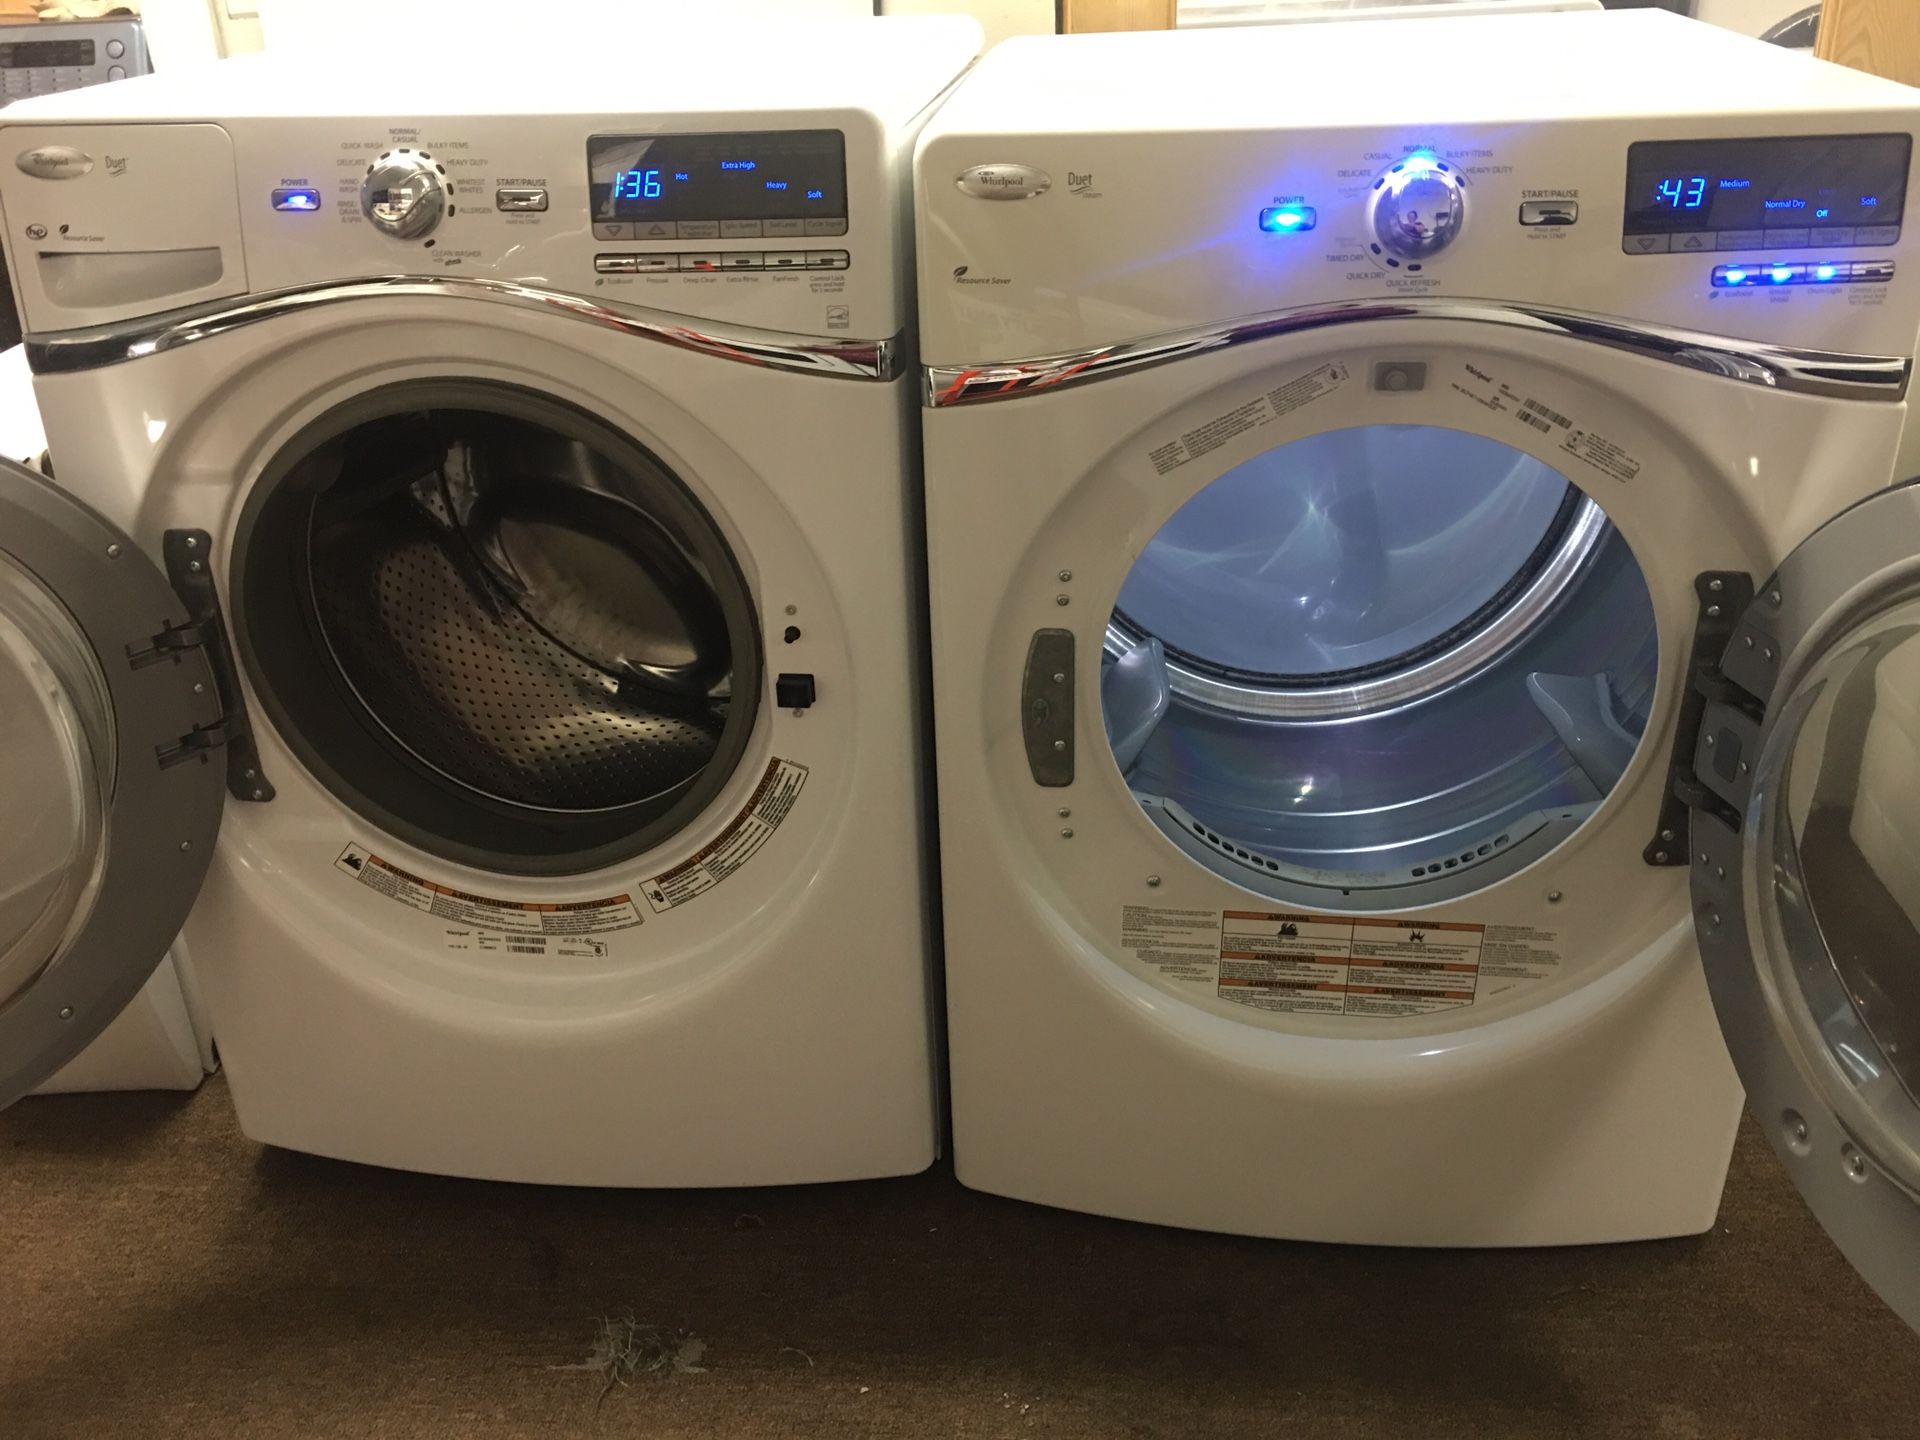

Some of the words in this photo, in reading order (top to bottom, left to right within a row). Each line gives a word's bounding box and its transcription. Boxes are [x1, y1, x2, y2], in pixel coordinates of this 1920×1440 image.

[1403, 145, 1436, 153] NORMAL
[105, 155, 127, 169] Duet
[721, 161, 739, 170] Extra
[739, 161, 756, 170] High
[1338, 170, 1372, 178] DELICATE
[1492, 166, 1513, 174] DUTY
[675, 172, 688, 180] Hot
[1067, 172, 1093, 186] Duet
[496, 178, 547, 187] START/PAUSE
[614, 170, 661, 198] 1:36
[766, 181, 787, 191] Heavy
[981, 176, 1023, 188] Whirlpool
[1720, 179, 1750, 188] Medium
[807, 190, 822, 198] Soft
[1522, 189, 1579, 198] START/PAUSE
[1273, 196, 1305, 204] POWER
[1765, 200, 1791, 209] Normal
[1792, 199, 1806, 210] Dry
[1860, 196, 1877, 206] Soft
[1816, 209, 1829, 218] Off
[1326, 254, 1349, 262] TIMED
[683, 276, 699, 284] Deep
[956, 277, 990, 285] Resource
[991, 277, 1012, 285] Saver
[1273, 913, 1310, 923] WARNING
